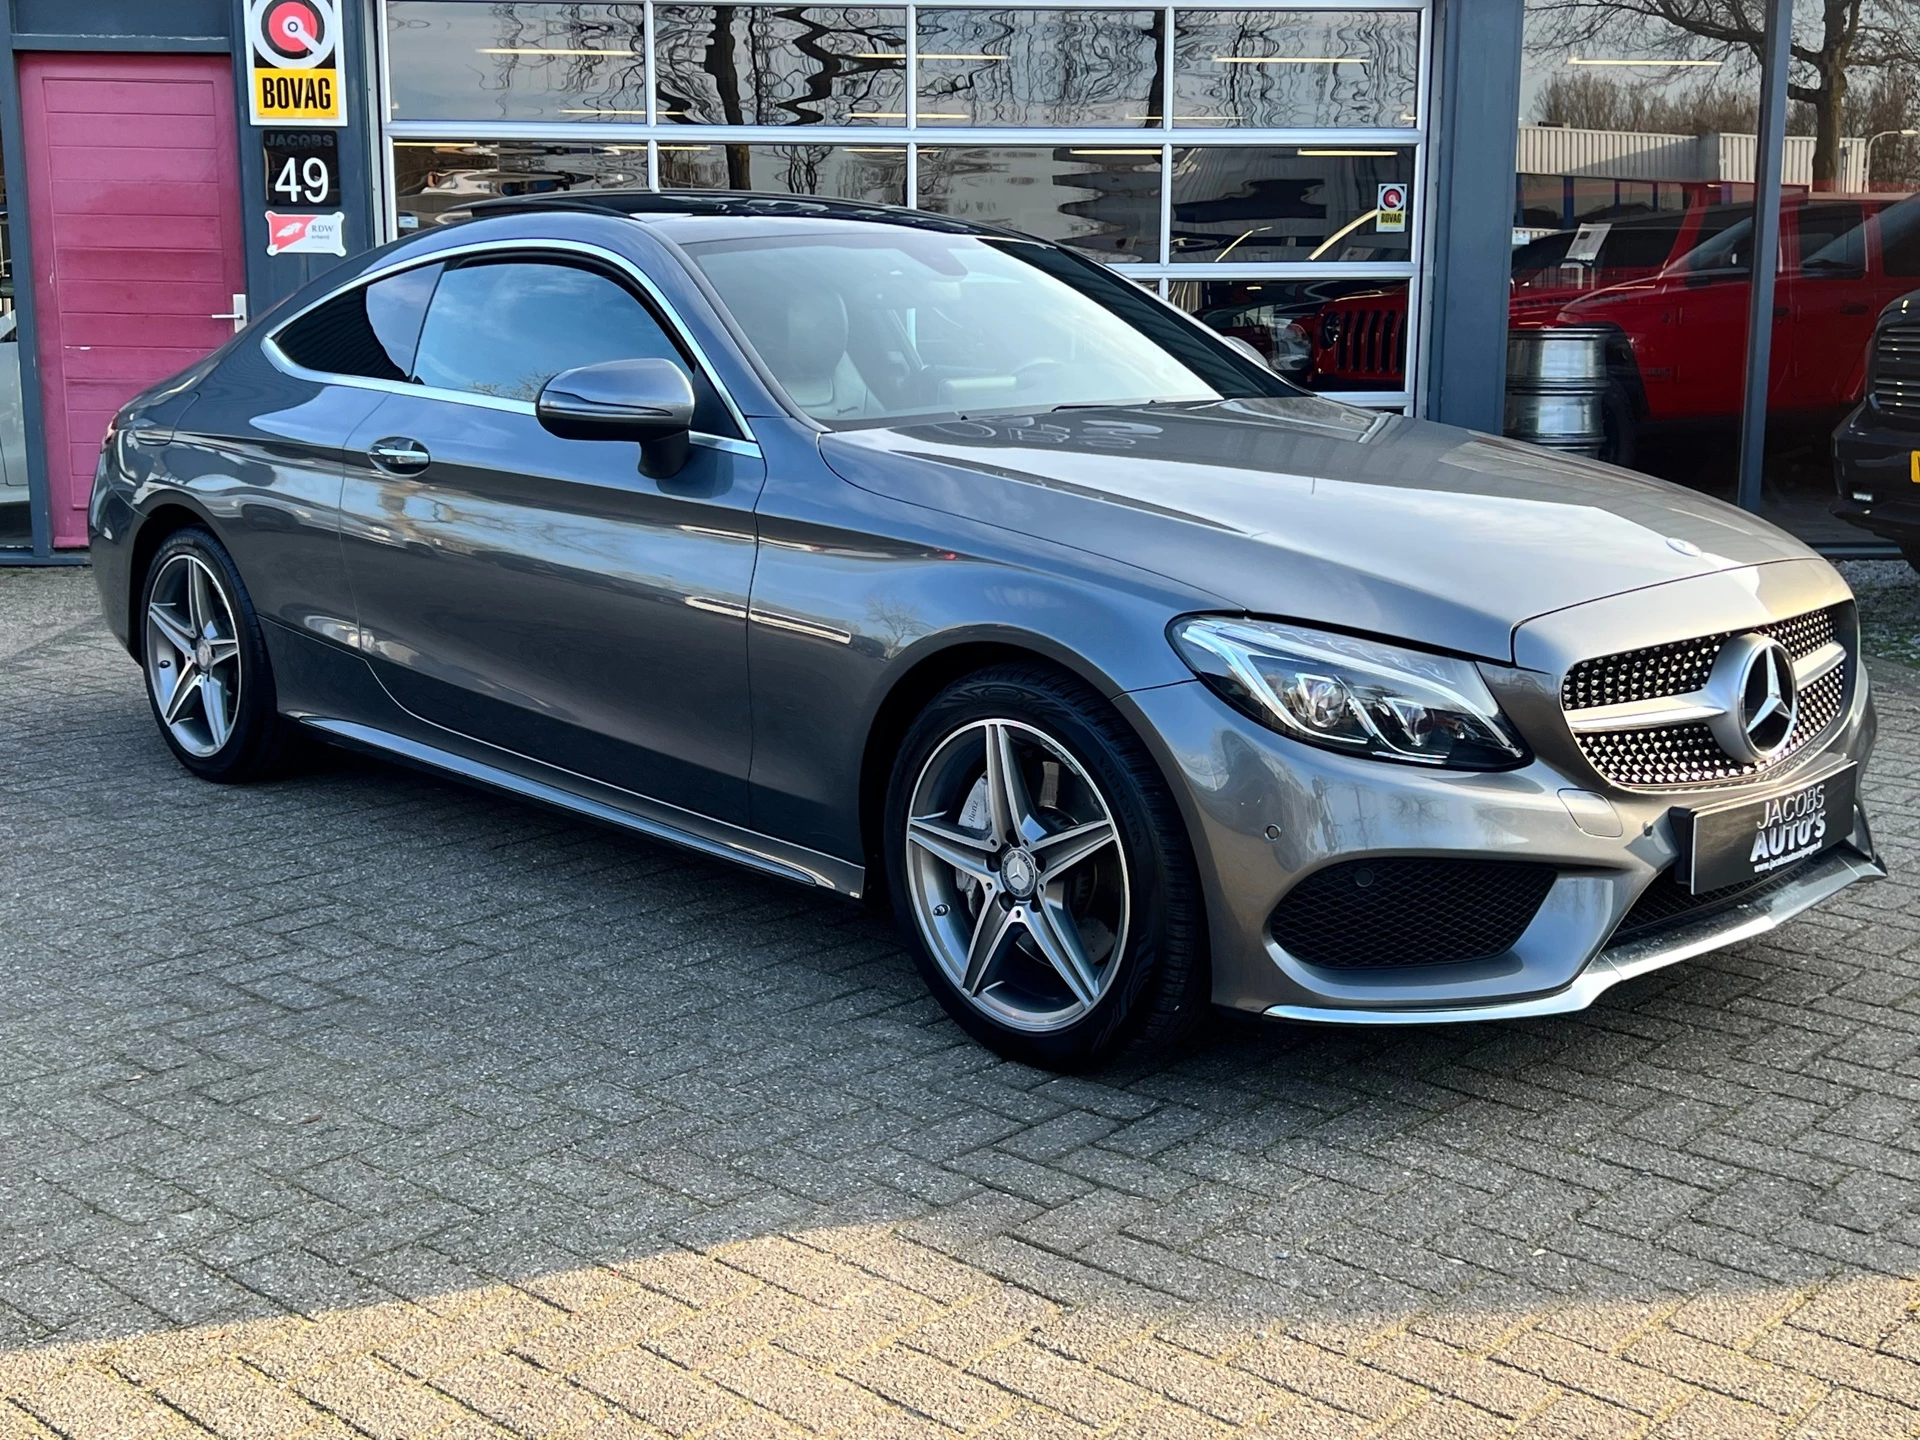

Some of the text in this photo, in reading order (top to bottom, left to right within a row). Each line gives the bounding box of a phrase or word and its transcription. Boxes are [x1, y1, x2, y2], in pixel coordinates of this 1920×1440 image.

[262, 76, 331, 110] BOVAG
[265, 134, 334, 147] JACOBS
[275, 157, 329, 203] 49
[311, 224, 334, 233] RDW
[1756, 783, 1825, 830] JACOBS
[1750, 809, 1827, 862] AUTO'S
